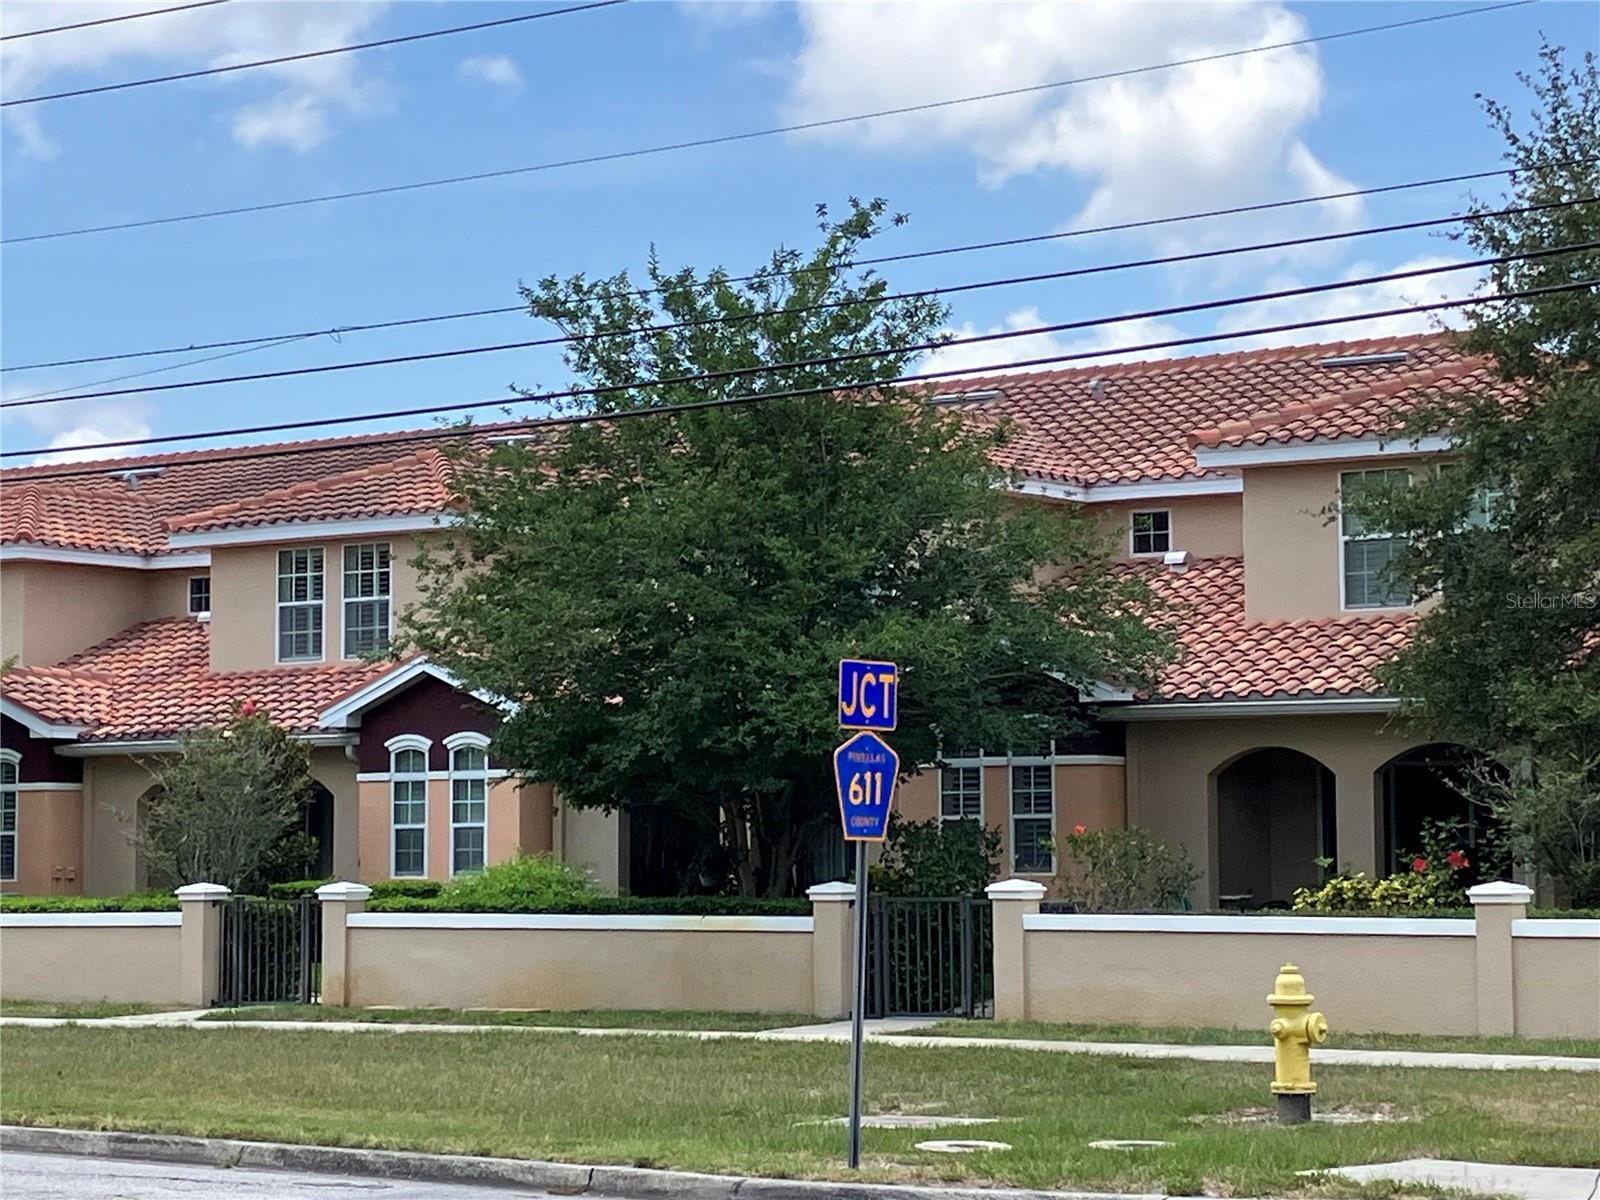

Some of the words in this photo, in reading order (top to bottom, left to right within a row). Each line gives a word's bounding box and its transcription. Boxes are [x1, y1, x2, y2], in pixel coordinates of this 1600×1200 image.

[841, 671, 895, 719] JCT
[849, 771, 882, 806] 611
[850, 815, 880, 828] COUNTY
